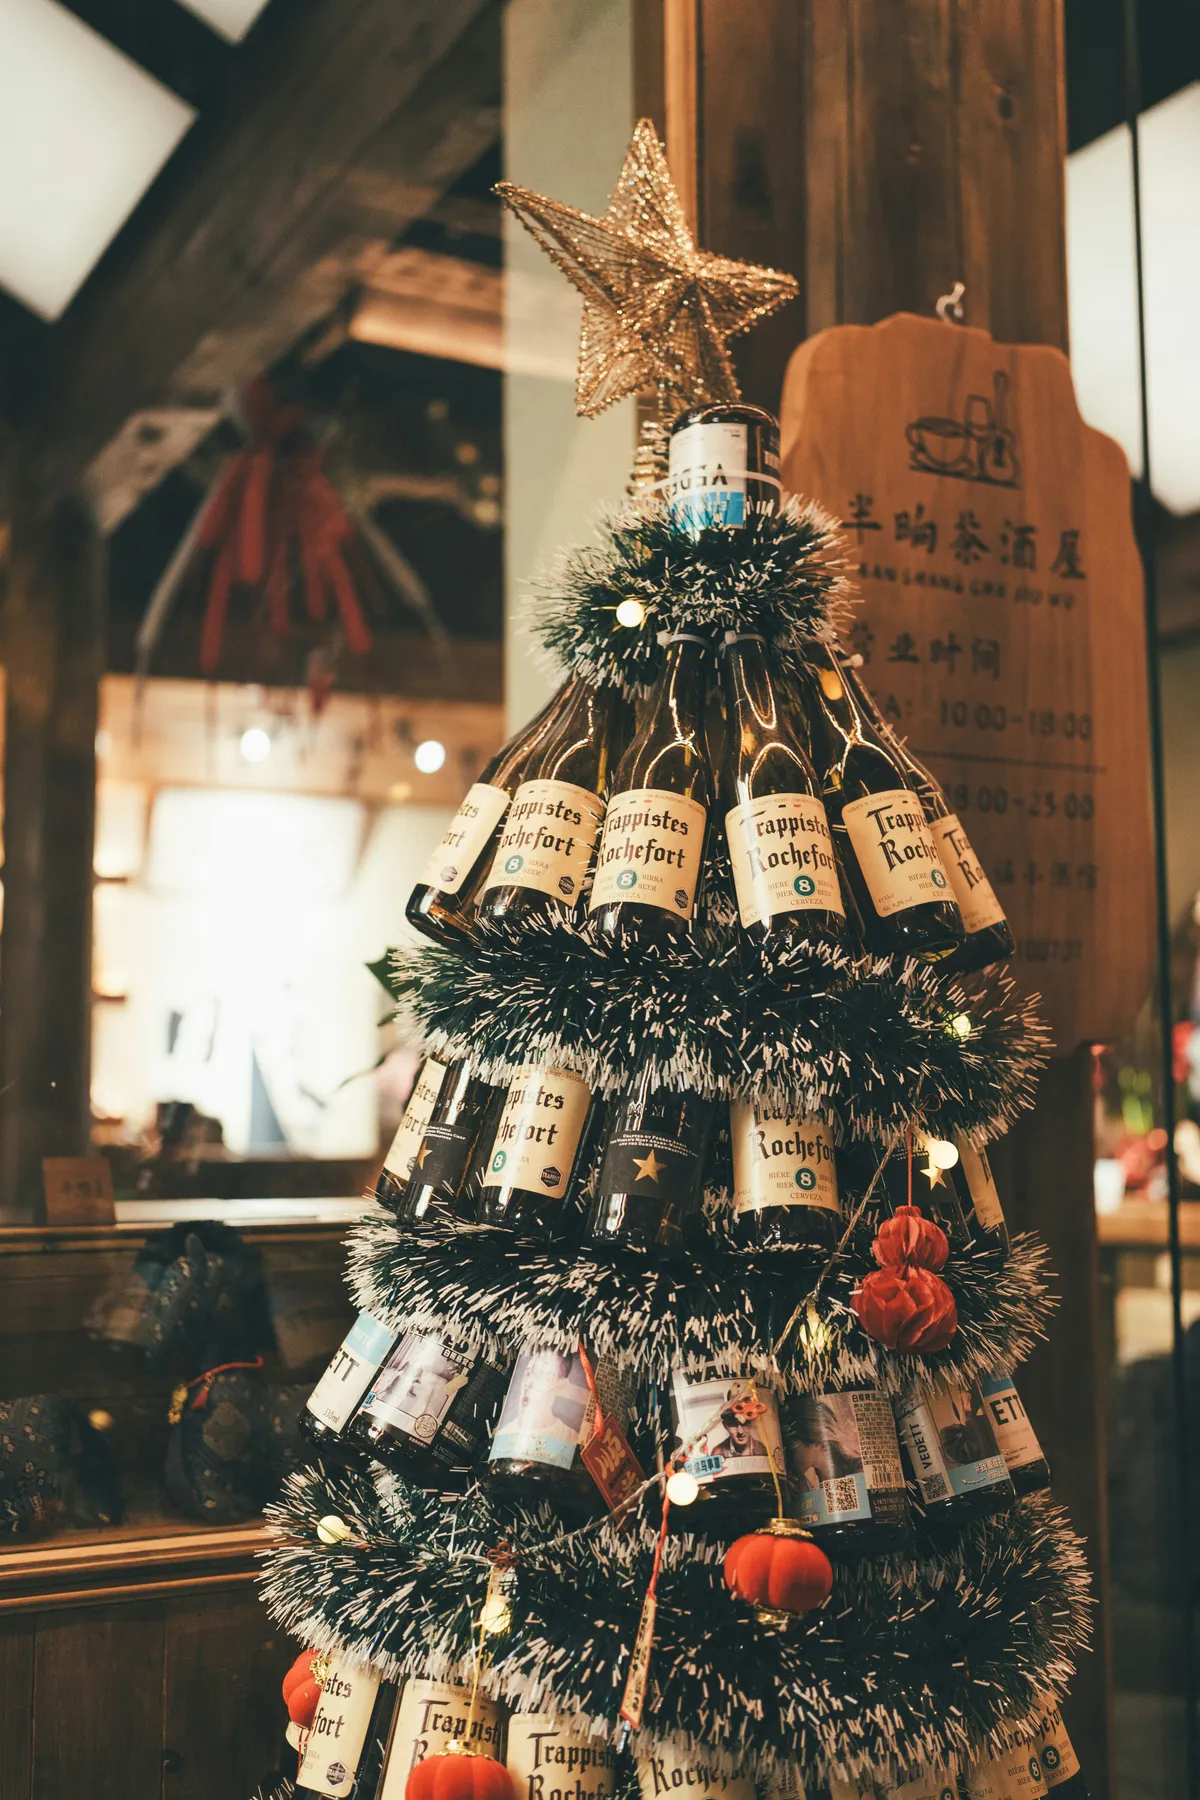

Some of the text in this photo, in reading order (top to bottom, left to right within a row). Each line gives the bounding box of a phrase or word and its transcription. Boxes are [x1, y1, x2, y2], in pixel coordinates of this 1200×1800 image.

[510, 798, 582, 825] appistes
[740, 810, 830, 846] Trappistes
[501, 825, 575, 856] ochefort
[748, 1130, 834, 1167] Rochefor
[790, 1192, 823, 1201] CERVEZA
[329, 1348, 360, 1382] TT
[909, 1423, 932, 1470] VEDETT
